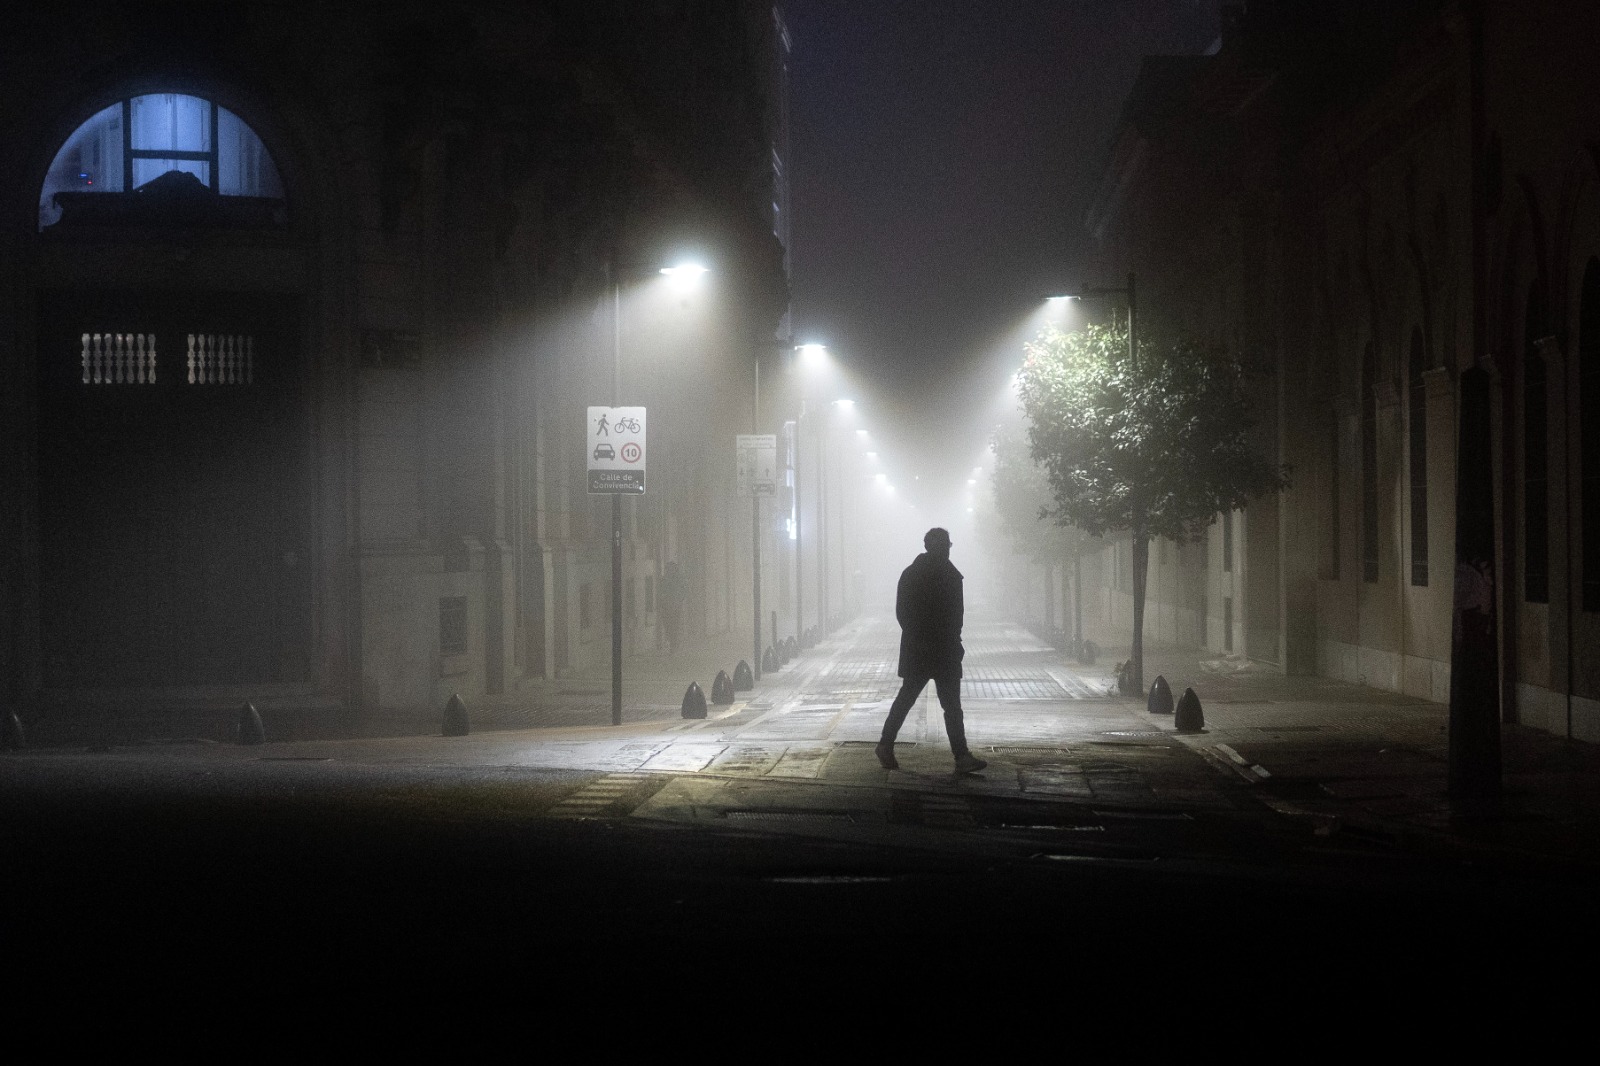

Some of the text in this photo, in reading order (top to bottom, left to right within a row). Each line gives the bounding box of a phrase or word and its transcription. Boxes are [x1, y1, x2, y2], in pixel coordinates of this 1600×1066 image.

[626, 448, 637, 457] 10
[600, 473, 633, 481] Calle de
[593, 481, 639, 489] Convivencia
